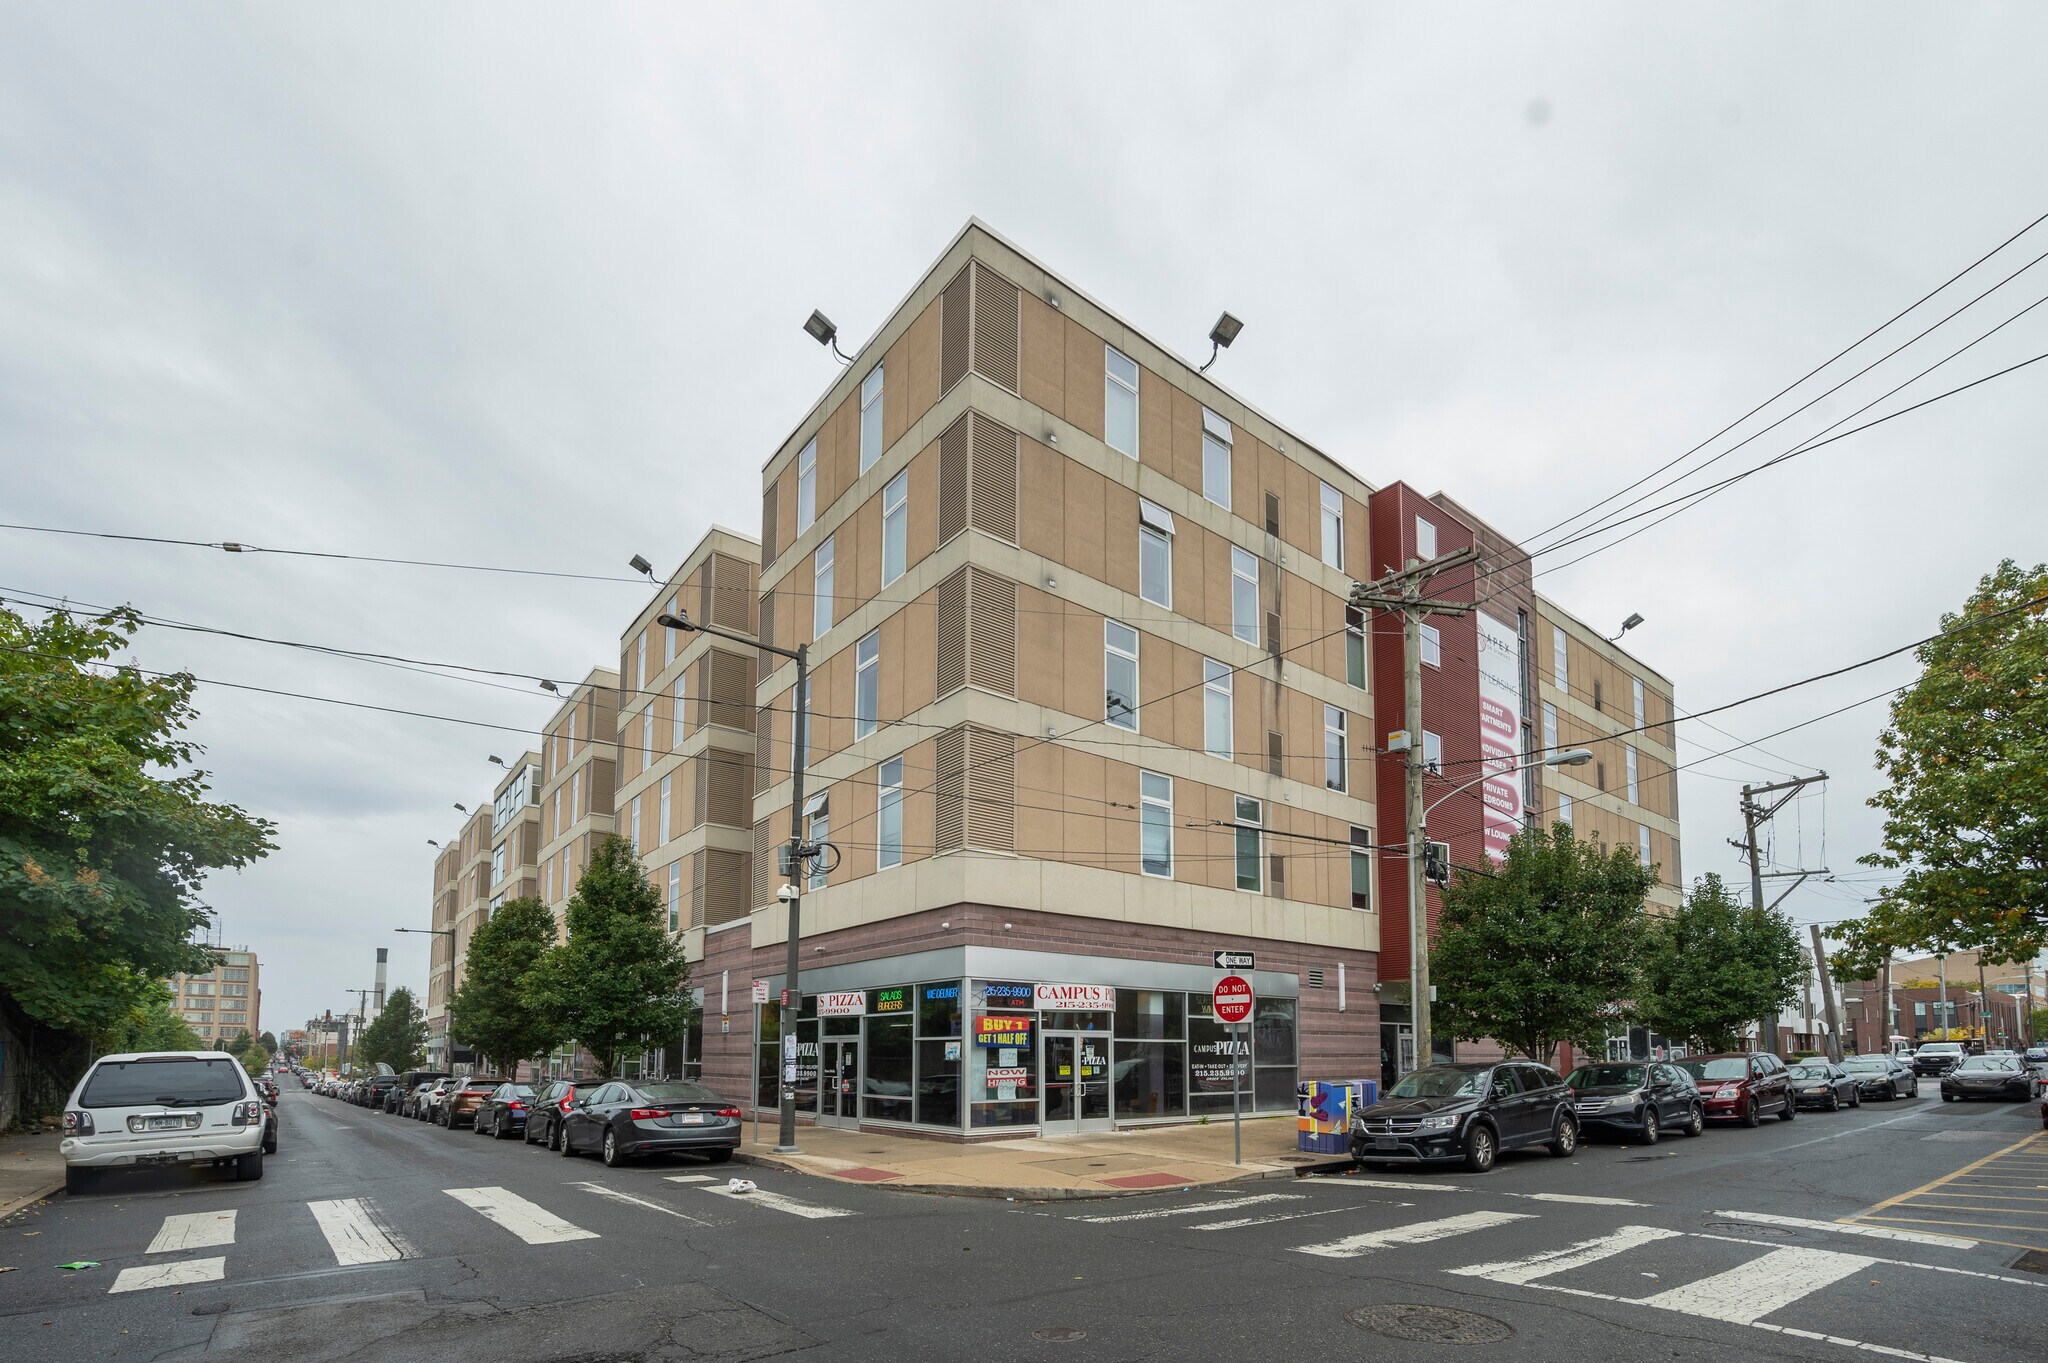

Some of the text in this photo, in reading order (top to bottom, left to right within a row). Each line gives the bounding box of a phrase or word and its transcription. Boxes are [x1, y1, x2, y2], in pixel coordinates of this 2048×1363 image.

[1487, 633, 1510, 654] APEX
[1482, 701, 1503, 717] SMART
[1481, 713, 1512, 733] ARTMENTS
[1483, 781, 1509, 798] PRIVATE
[1484, 793, 1514, 811] EDROOMS
[1225, 956, 1251, 965] ONE WAY
[1037, 986, 1100, 1001] CAMPUS
[1218, 984, 1246, 994] DO NOT
[829, 993, 864, 1007] PIZZA
[877, 1000, 903, 1011] BURGERS
[1221, 1005, 1245, 1014] ENTER
[983, 1018, 1023, 1031] BUY 1
[978, 1033, 1028, 1046] GET 1 HALF OFF
[796, 1042, 819, 1057] PIZZA
[1193, 1044, 1217, 1053] CAMPUS
[1083, 1056, 1106, 1065] PIZZA
[1195, 1069, 1246, 1077] 215.235.990
